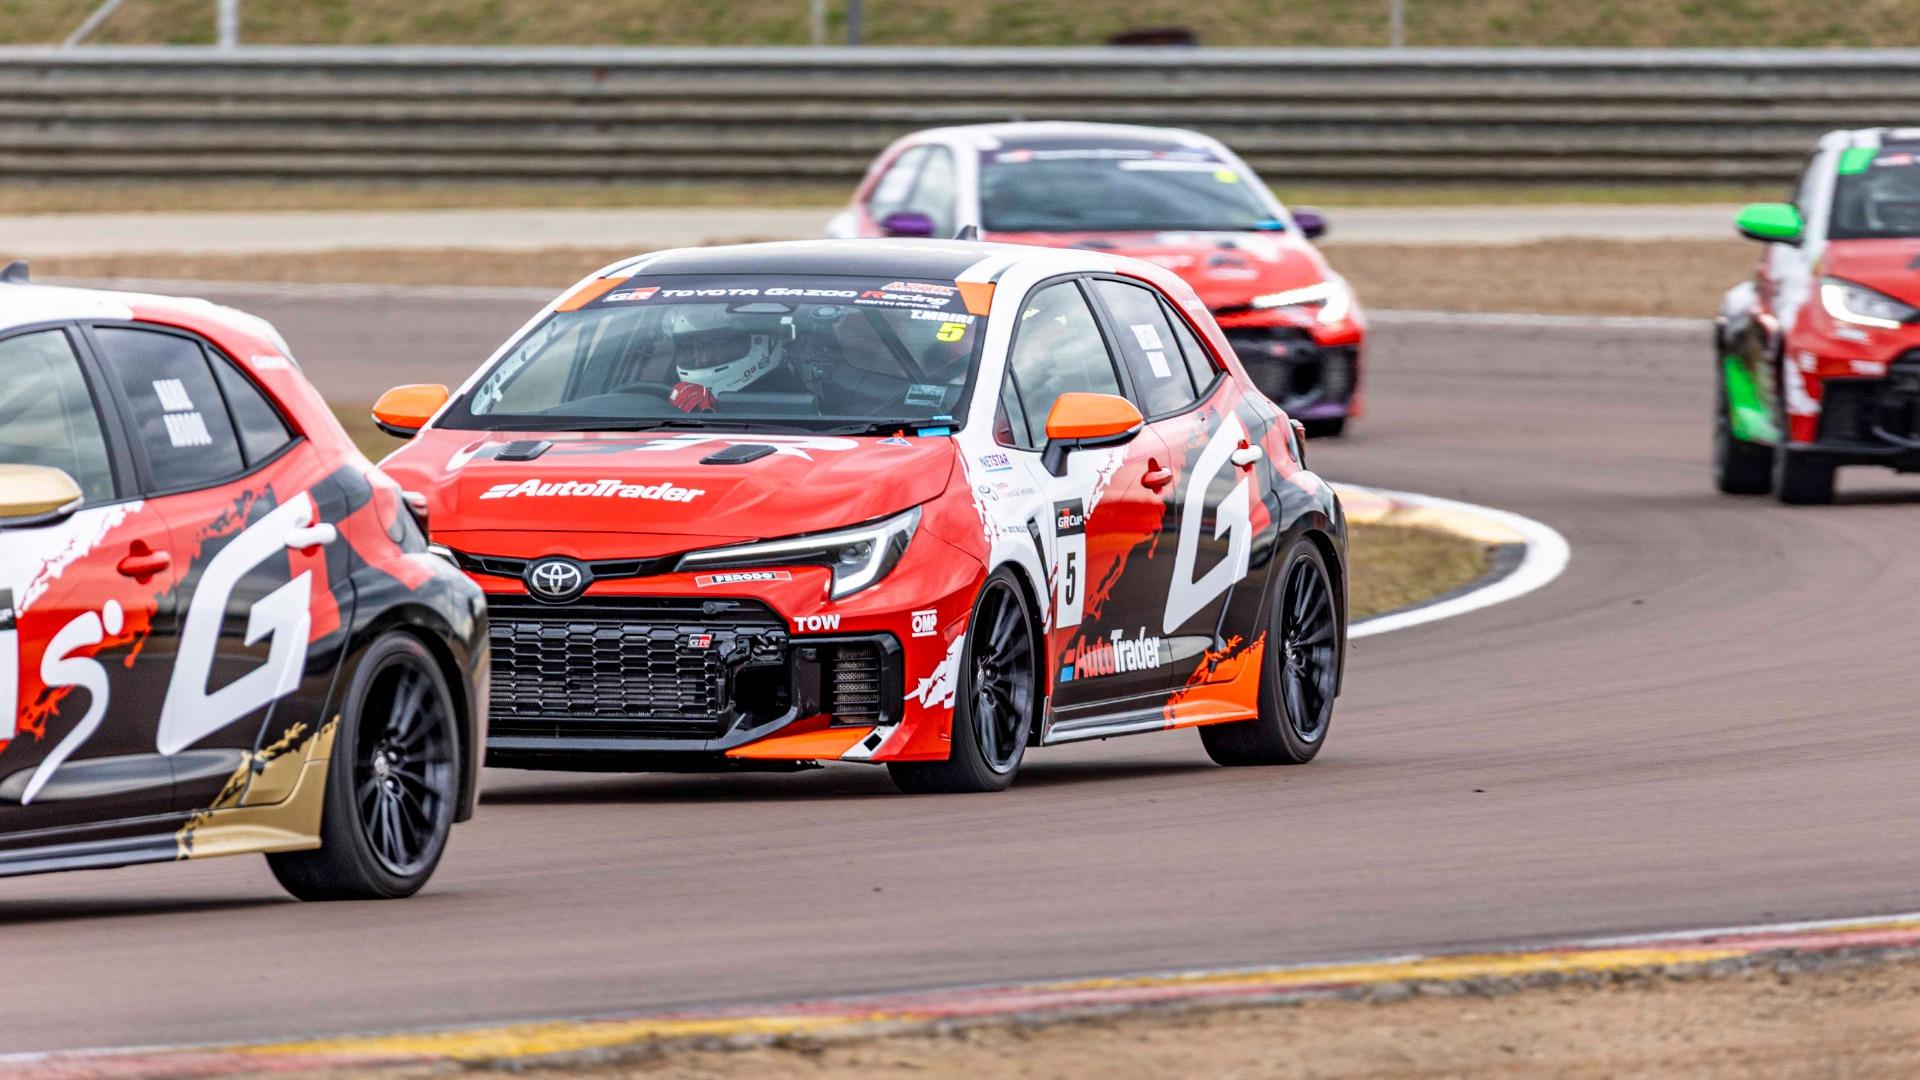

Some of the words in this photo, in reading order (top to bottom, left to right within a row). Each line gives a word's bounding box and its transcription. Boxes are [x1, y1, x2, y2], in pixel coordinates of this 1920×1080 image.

[662, 289, 759, 297] TOYOTA
[861, 290, 950, 306] Racing
[896, 301, 940, 309] AFRICA
[936, 322, 967, 342] 5
[979, 453, 1010, 469] NETSTAR
[508, 479, 705, 503] AutoTrader
[1008, 525, 1028, 534] DUNLO
[1163, 410, 1253, 634] G
[714, 572, 773, 583] FERODO
[1065, 552, 1077, 606] 5
[793, 614, 841, 631] TOW
[911, 613, 938, 633] OMP
[1073, 626, 1160, 680] AutoTrader
